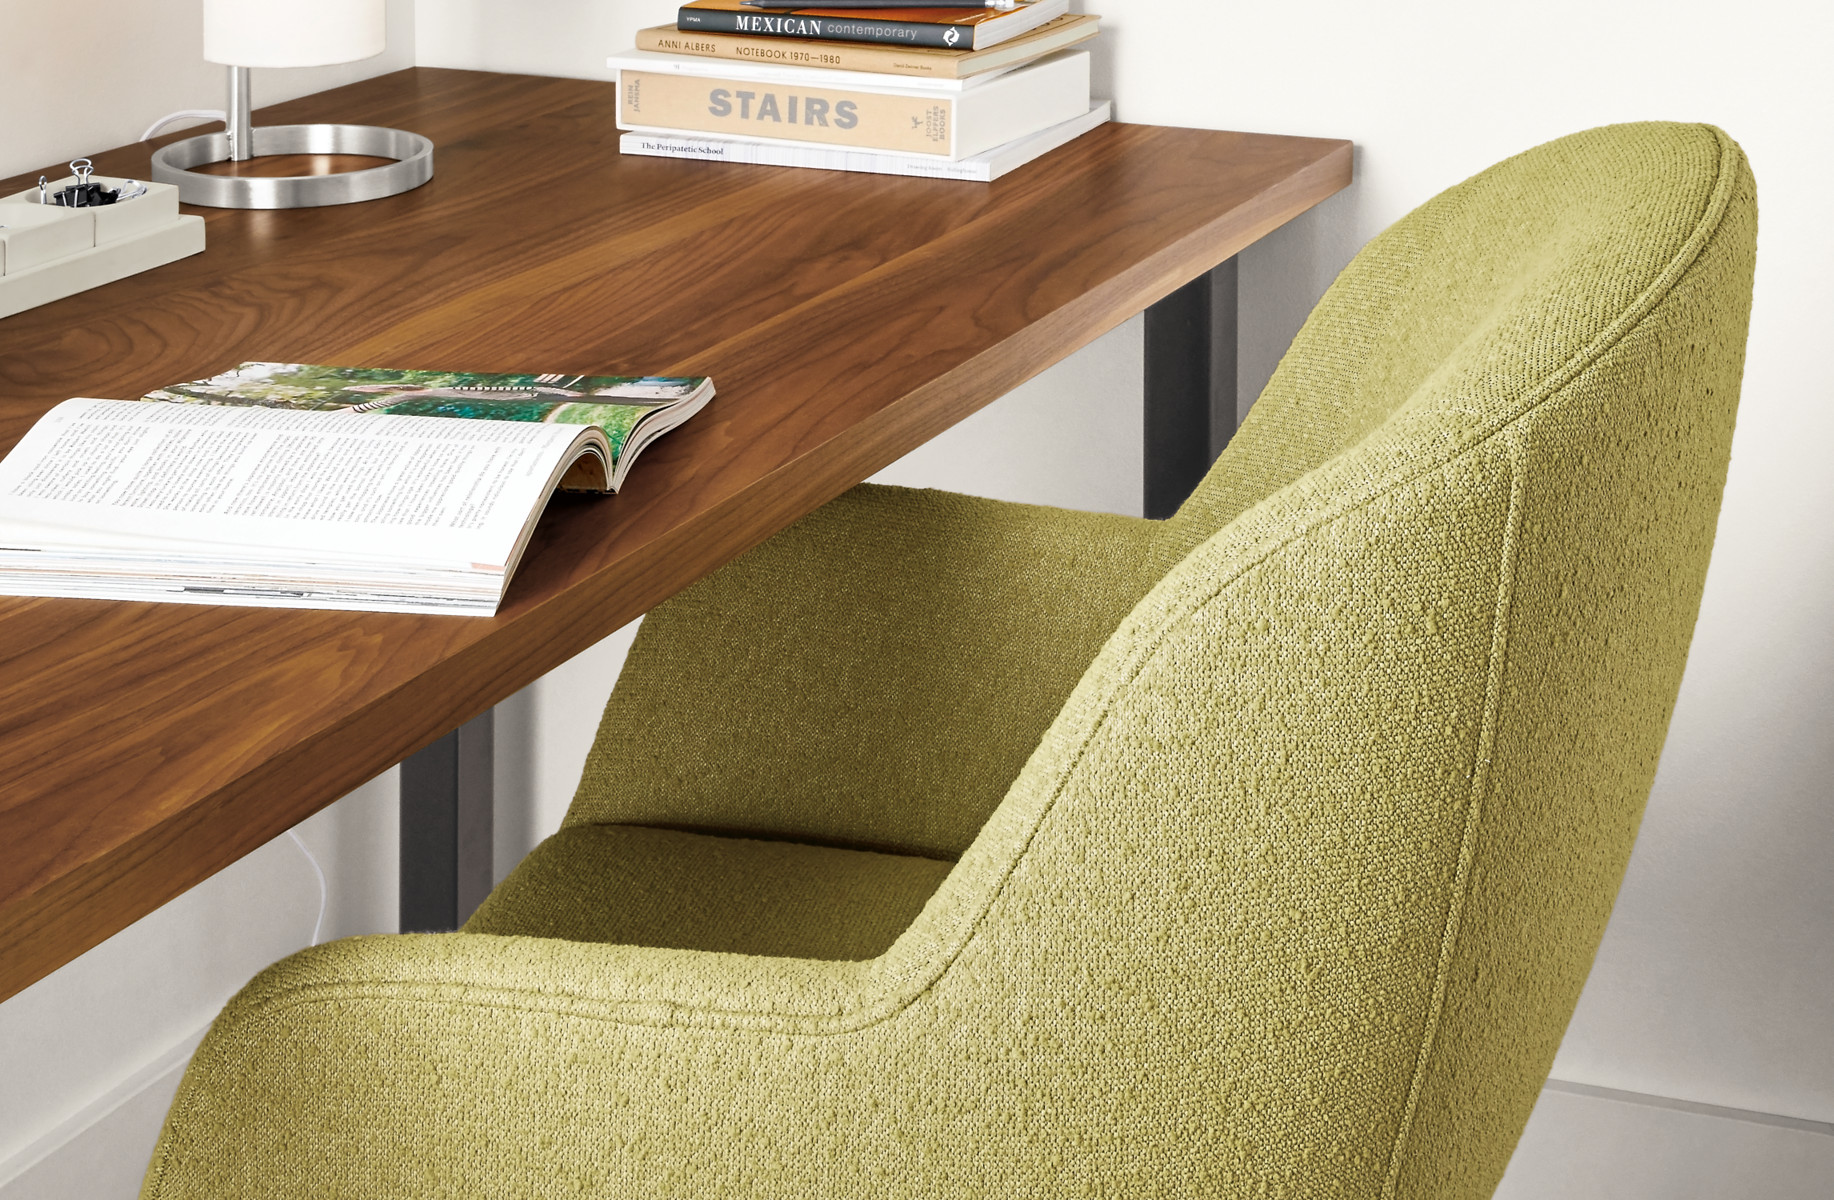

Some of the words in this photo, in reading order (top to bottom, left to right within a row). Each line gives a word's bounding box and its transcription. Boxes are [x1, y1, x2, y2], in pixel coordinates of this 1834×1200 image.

[735, 14, 822, 35] MEXICAN
[828, 22, 918, 41] contemporary
[658, 39, 681, 51] ANNI
[684, 40, 717, 53] ALBERS
[736, 46, 787, 60] NOTEBOOK
[708, 88, 858, 129] STAIRS
[925, 109, 933, 138] JOOST
[641, 142, 655, 150] The
[656, 143, 697, 153] Peripatetic
[698, 145, 724, 155] School
